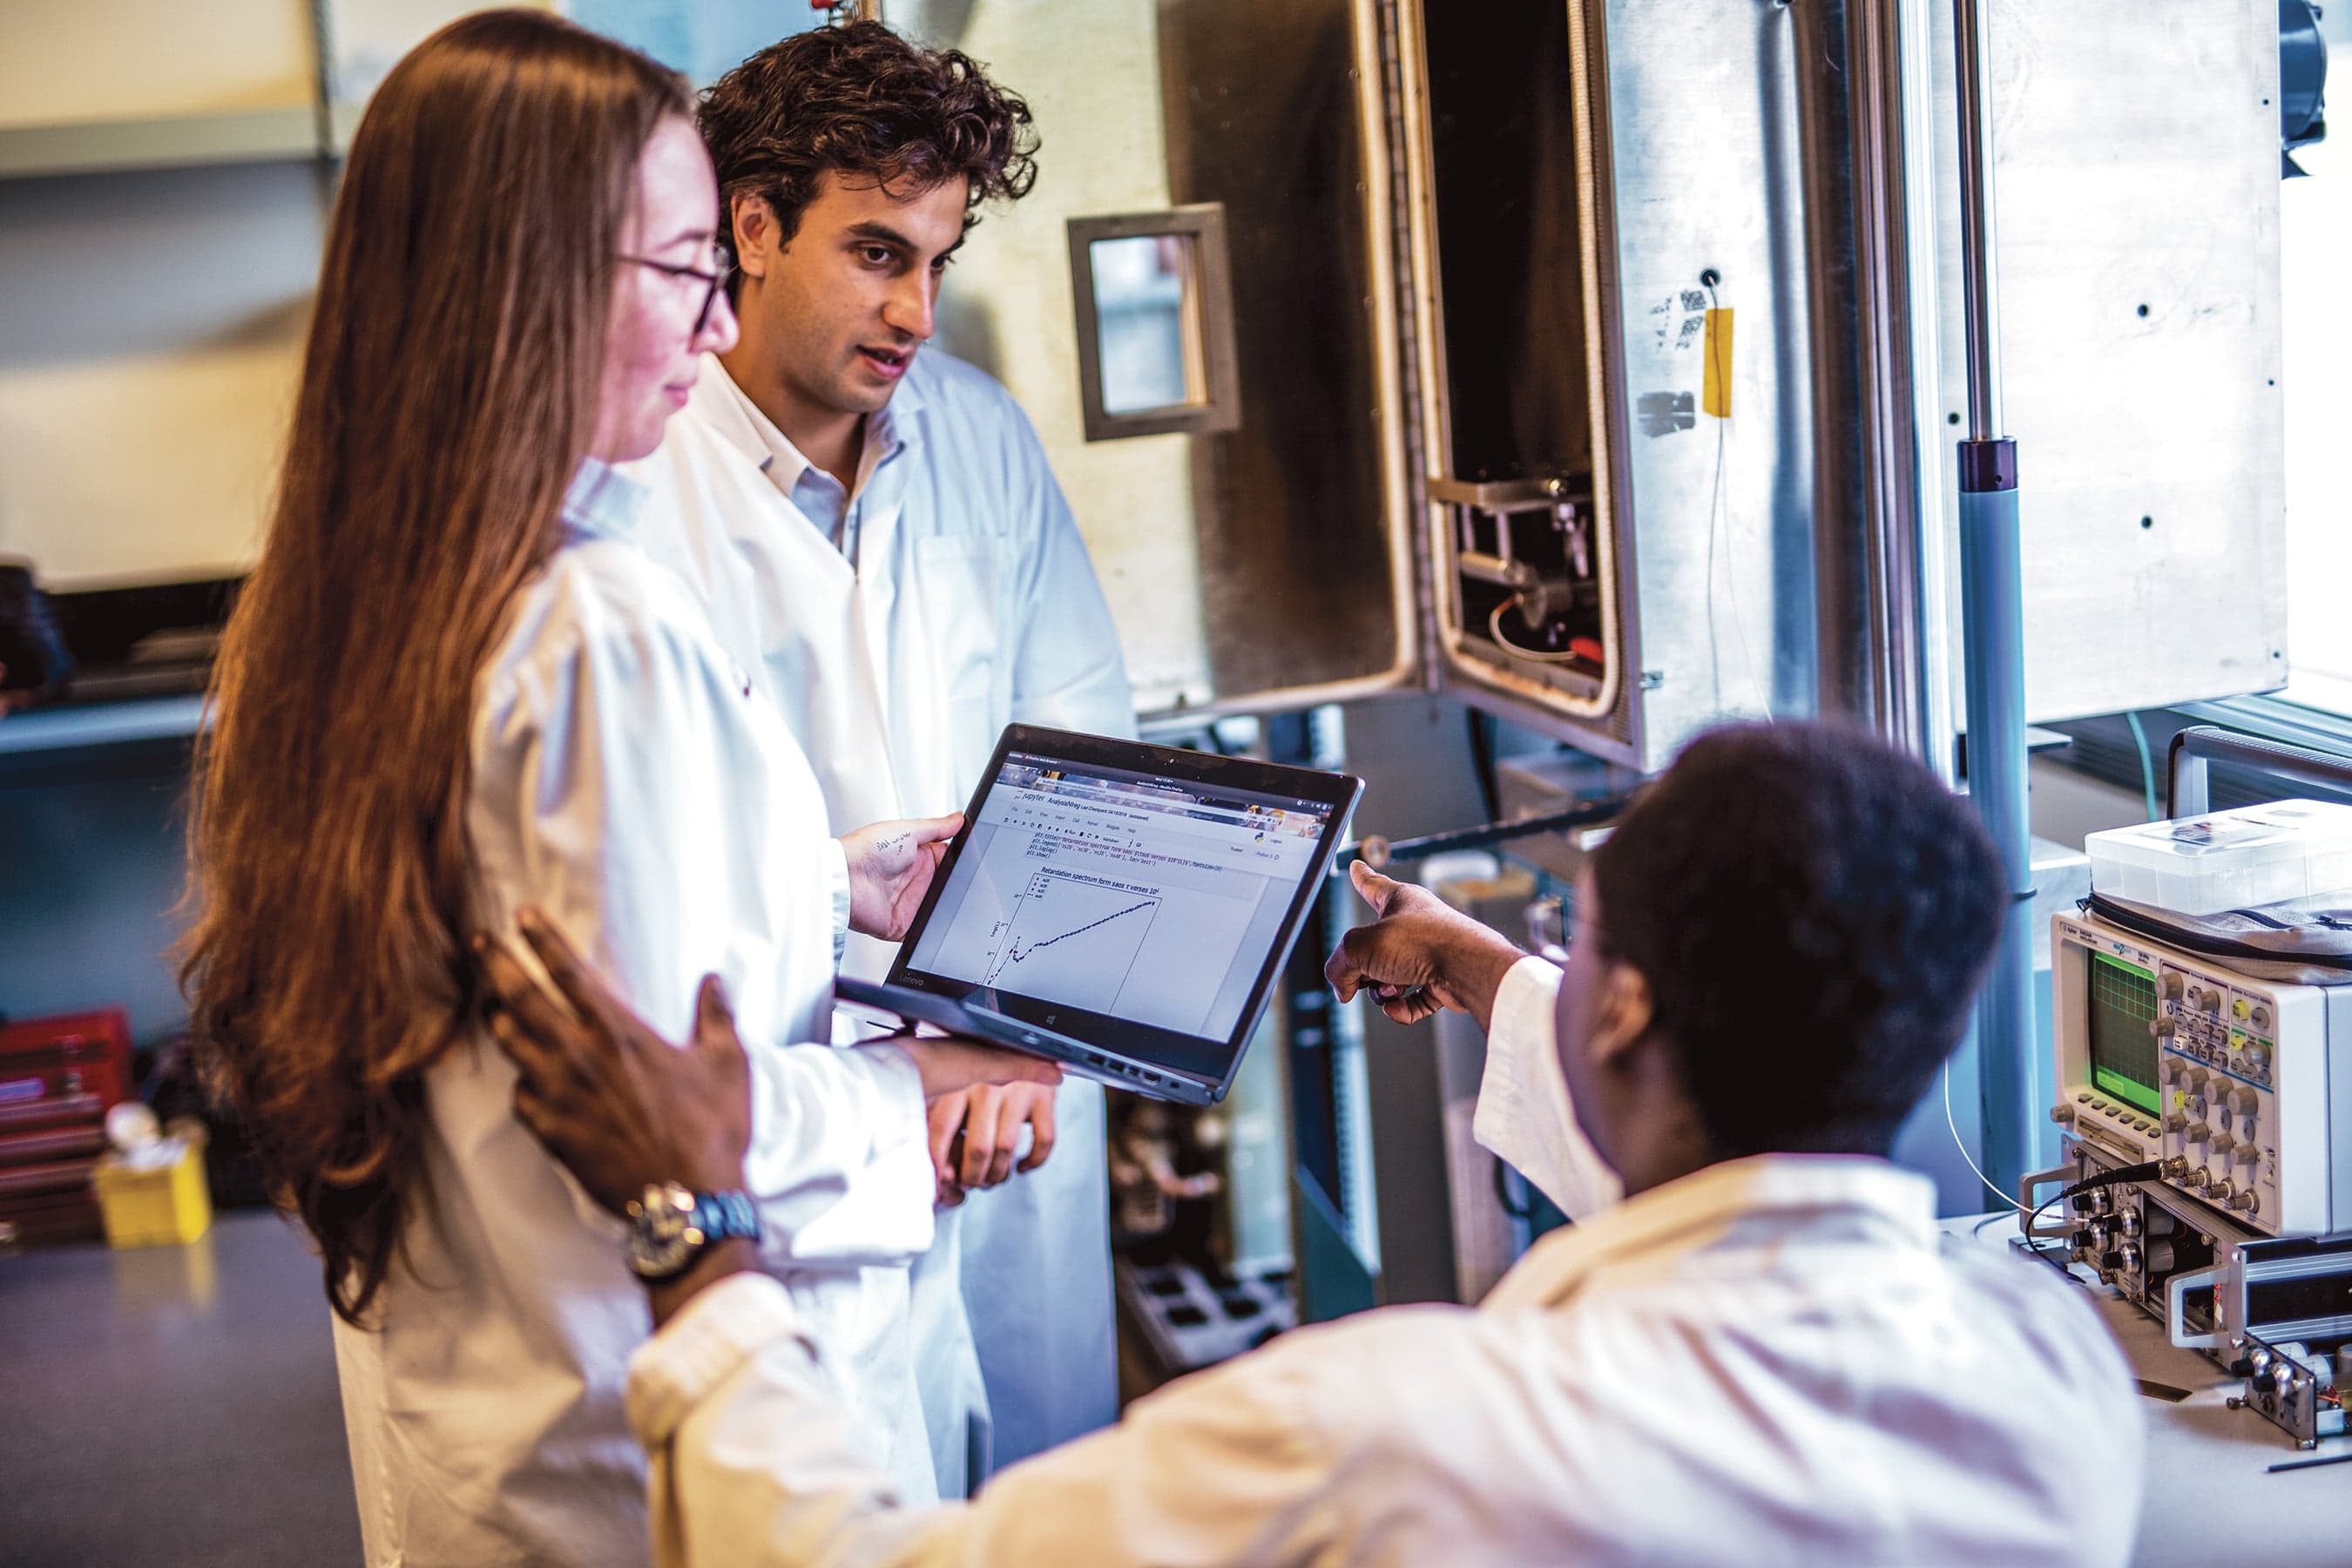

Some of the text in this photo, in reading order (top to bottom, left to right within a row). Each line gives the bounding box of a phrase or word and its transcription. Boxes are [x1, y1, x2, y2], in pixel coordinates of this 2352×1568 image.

[1041, 866, 1072, 878] Retardation
[1072, 872, 1097, 885] spectrum
[1097, 878, 1111, 886] form
[1130, 885, 1148, 894] verses
[899, 974, 924, 987] Lenovo
